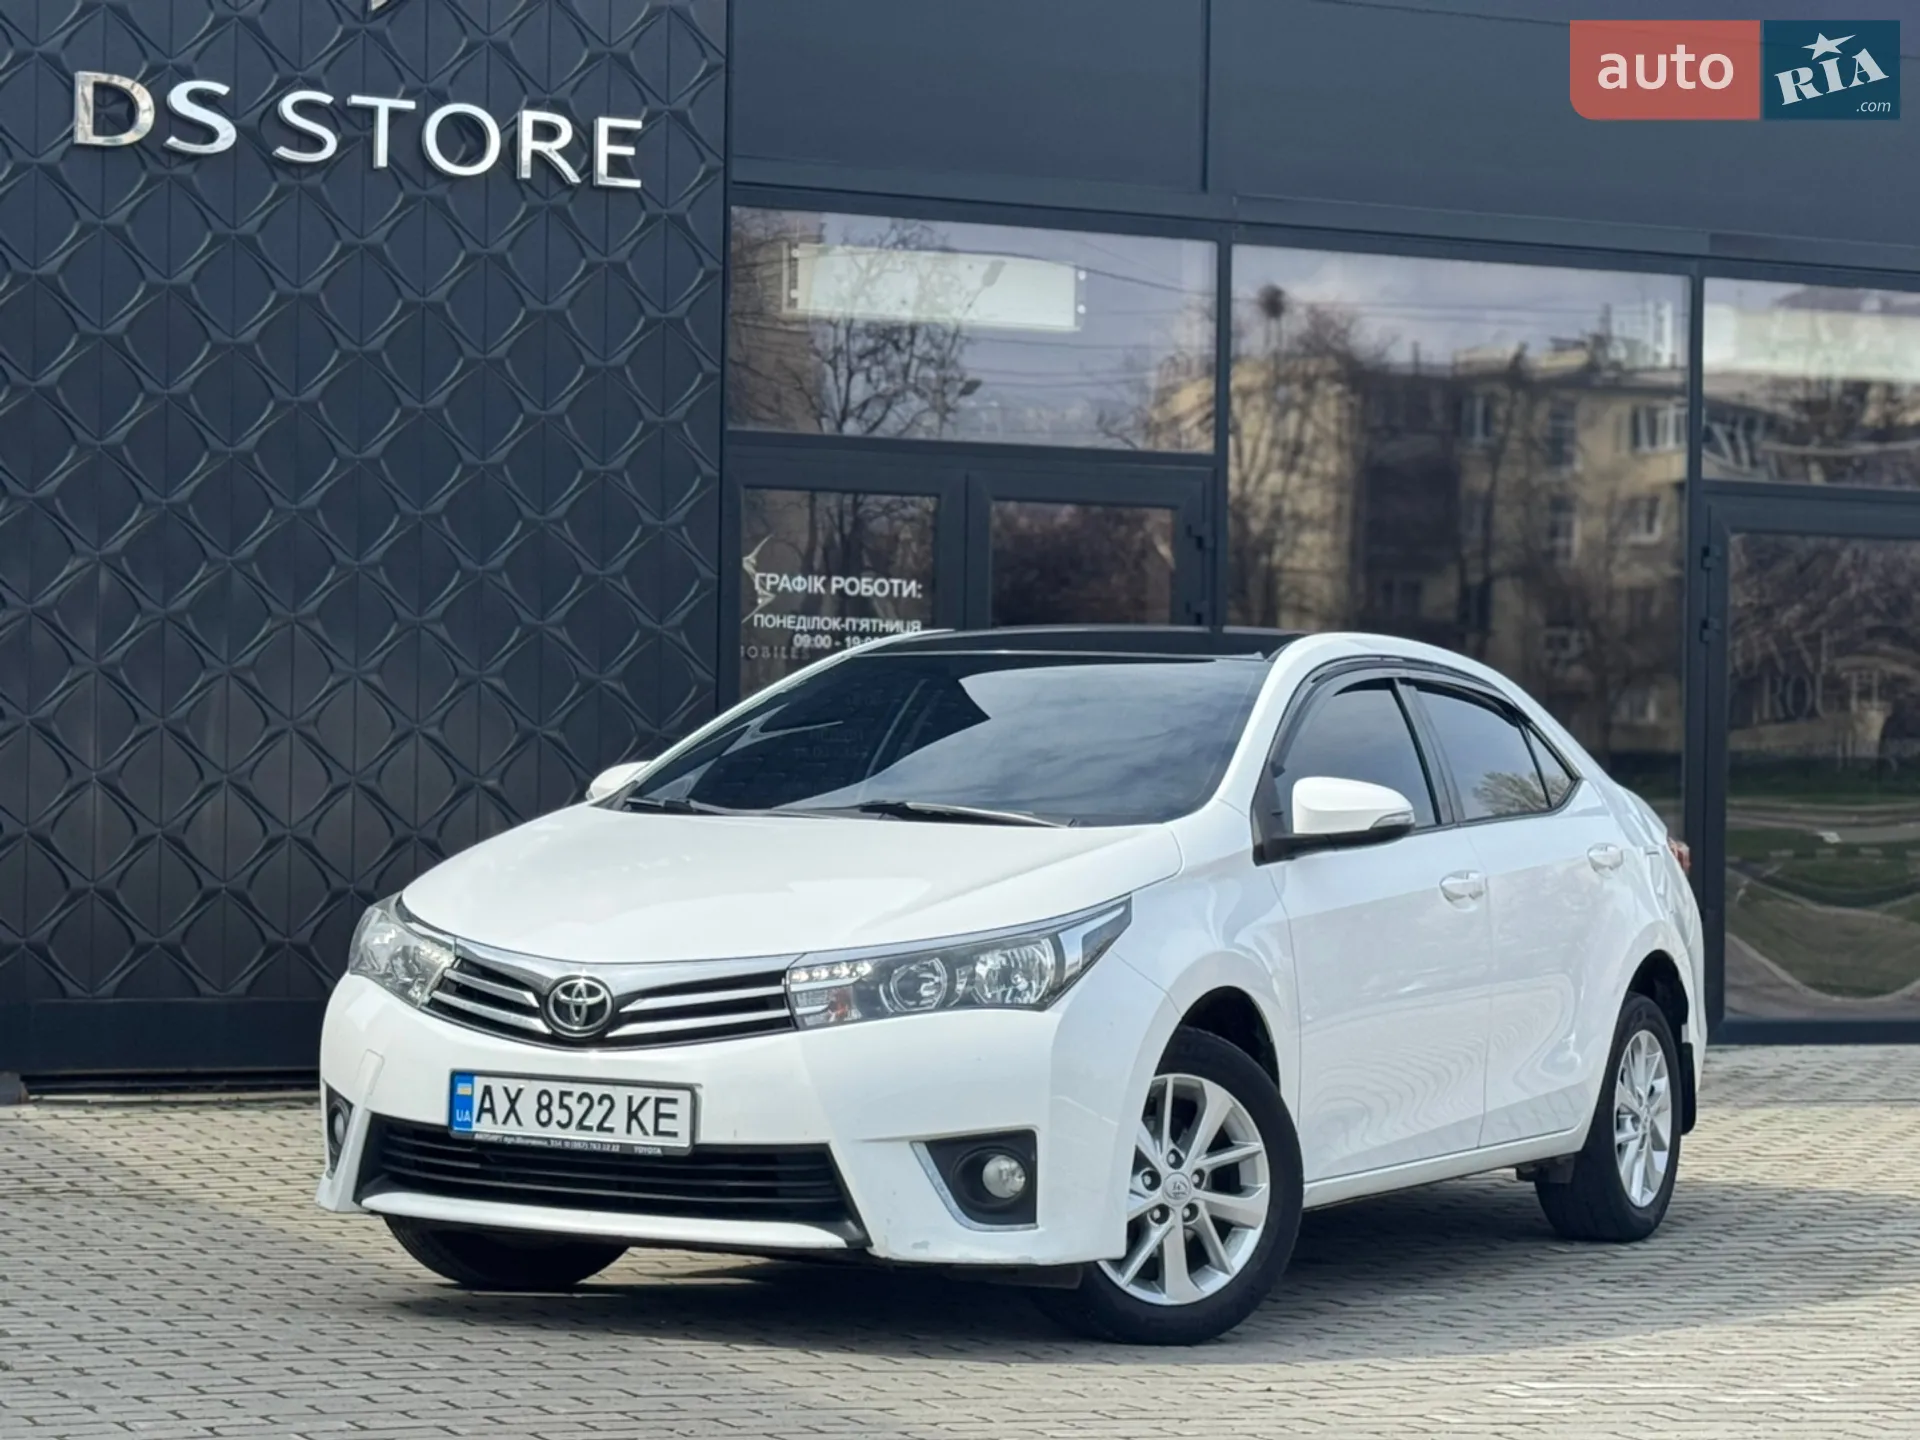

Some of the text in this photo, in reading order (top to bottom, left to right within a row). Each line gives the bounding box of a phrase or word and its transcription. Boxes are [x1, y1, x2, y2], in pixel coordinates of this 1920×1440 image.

[73, 70, 643, 190] DS STORE
[754, 572, 923, 599] ГРАФІК РОБОТИ:
[793, 634, 831, 649] 09:00
[845, 636, 882, 648] 19:0
[456, 1111, 472, 1123] UA
[475, 1084, 679, 1138] AX 8522 KE
